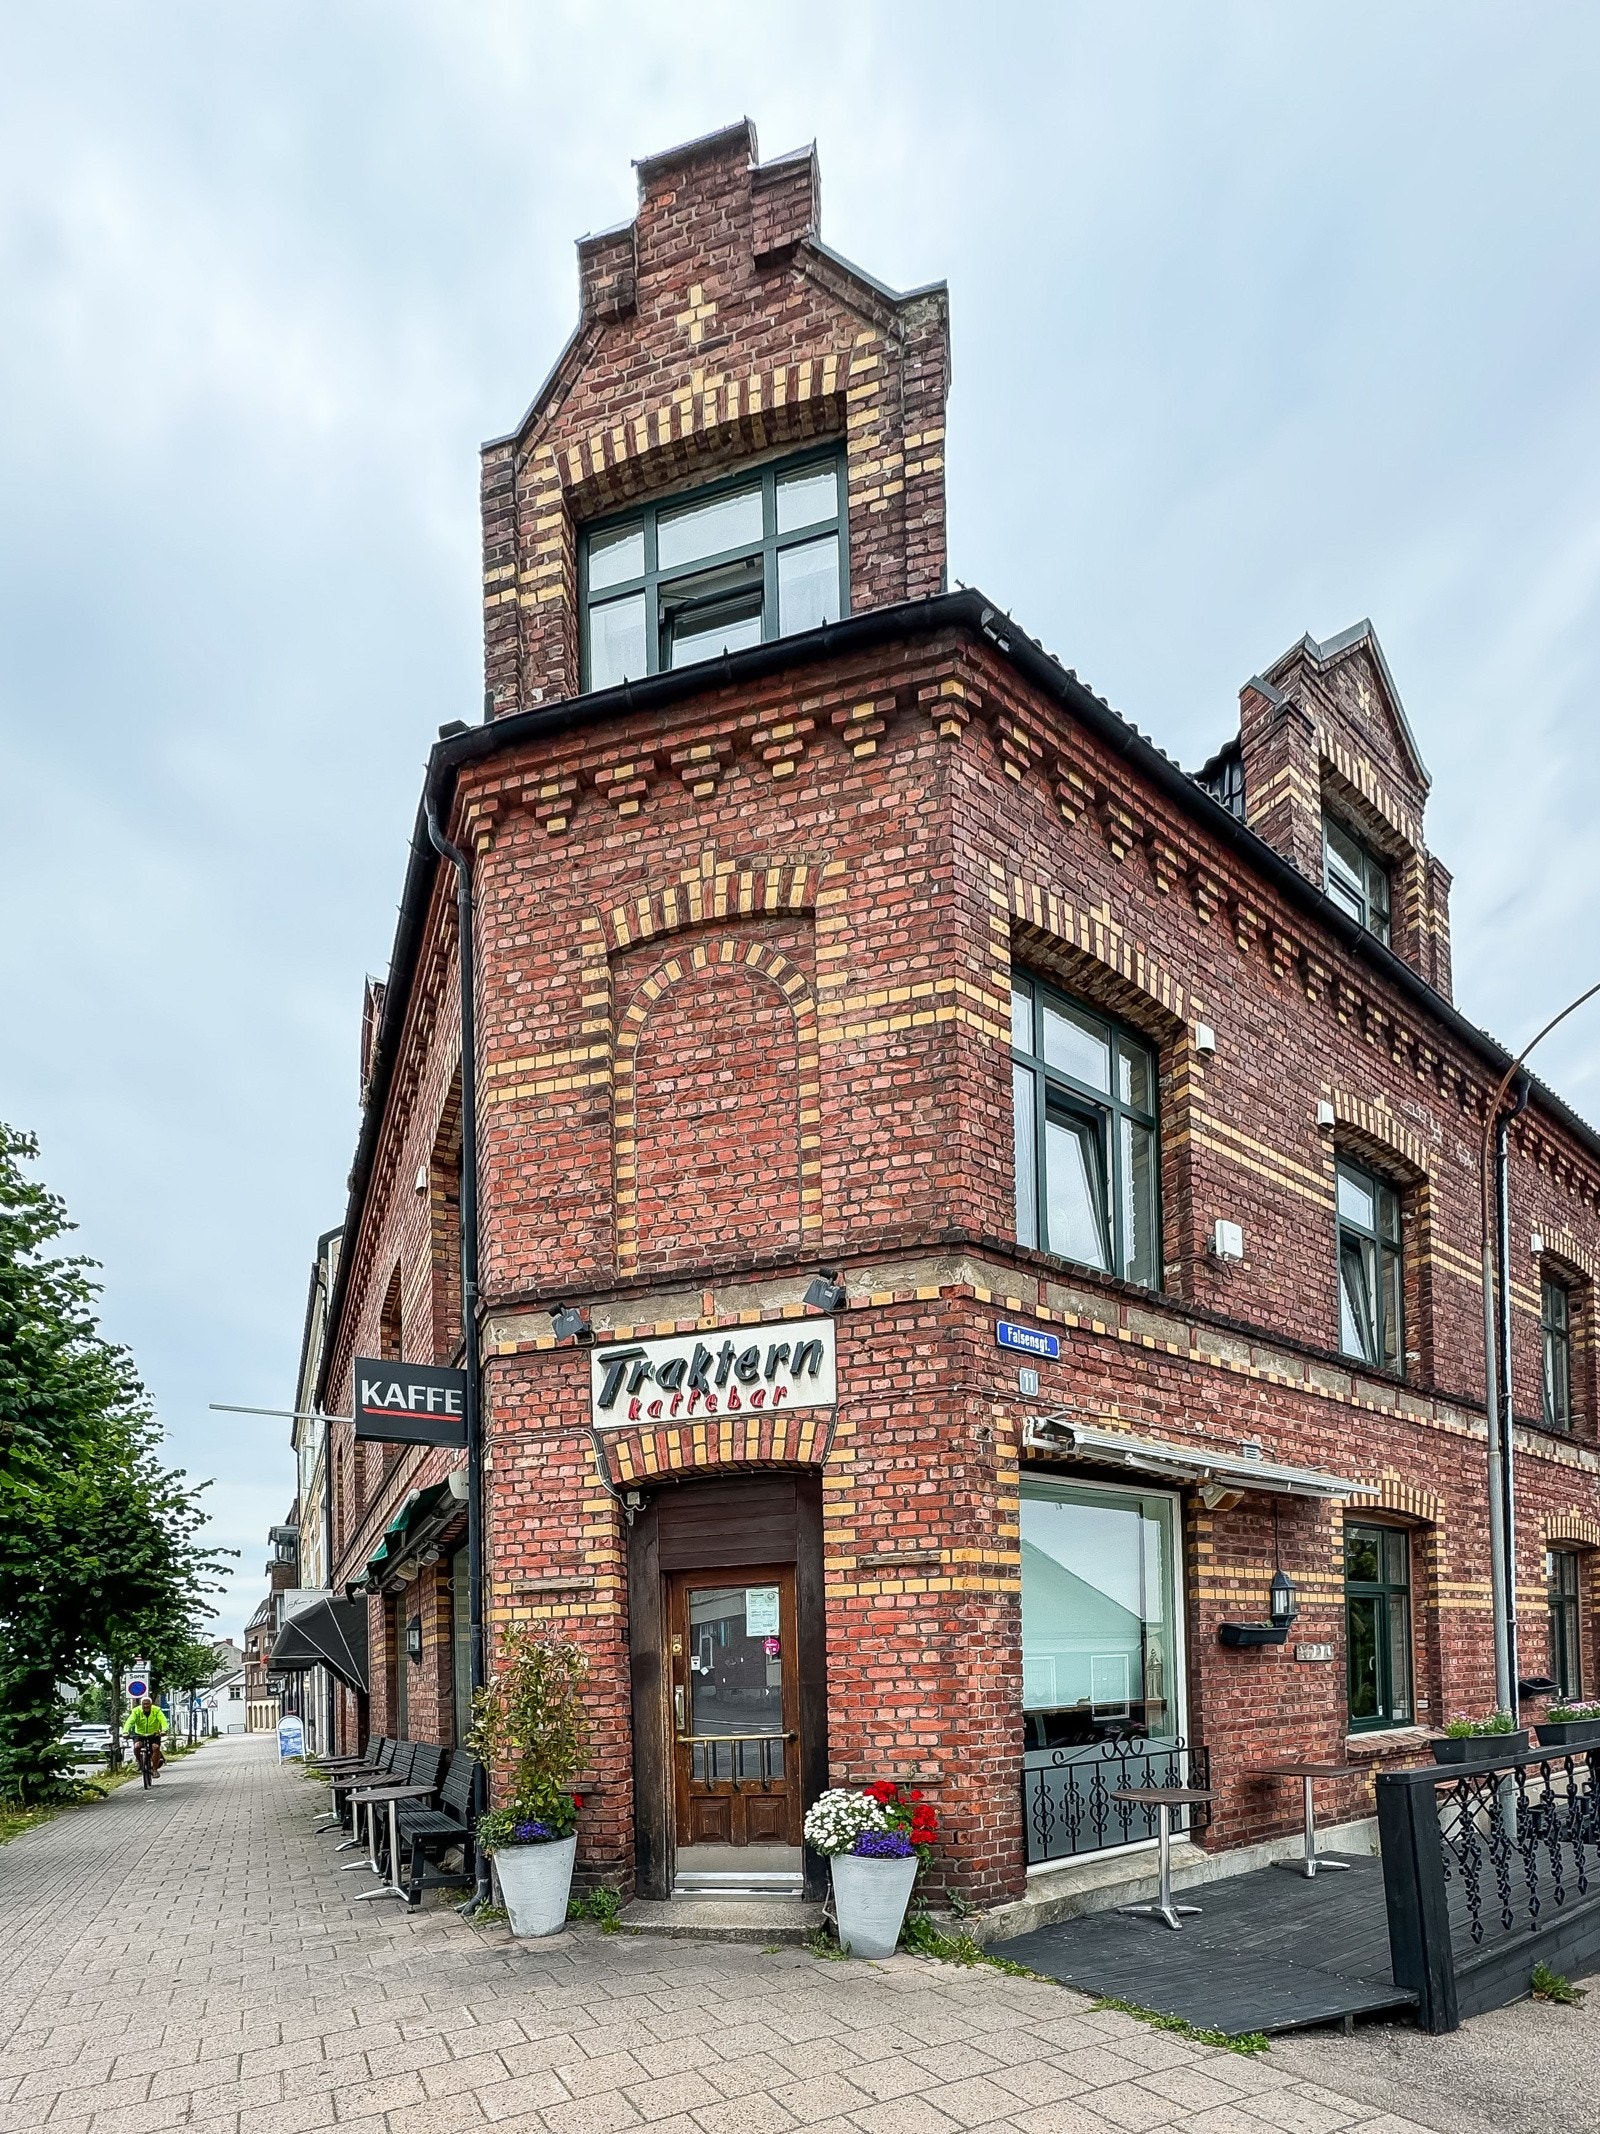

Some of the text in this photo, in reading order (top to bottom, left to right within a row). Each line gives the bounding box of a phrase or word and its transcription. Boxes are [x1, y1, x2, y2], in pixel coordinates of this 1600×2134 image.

[1007, 1326, 1051, 1353] Falsensgt.
[597, 1339, 824, 1407] Traktern
[1023, 1372, 1034, 1392] 11
[361, 1379, 463, 1414] KAFFE
[628, 1385, 788, 1421] kaffebar
